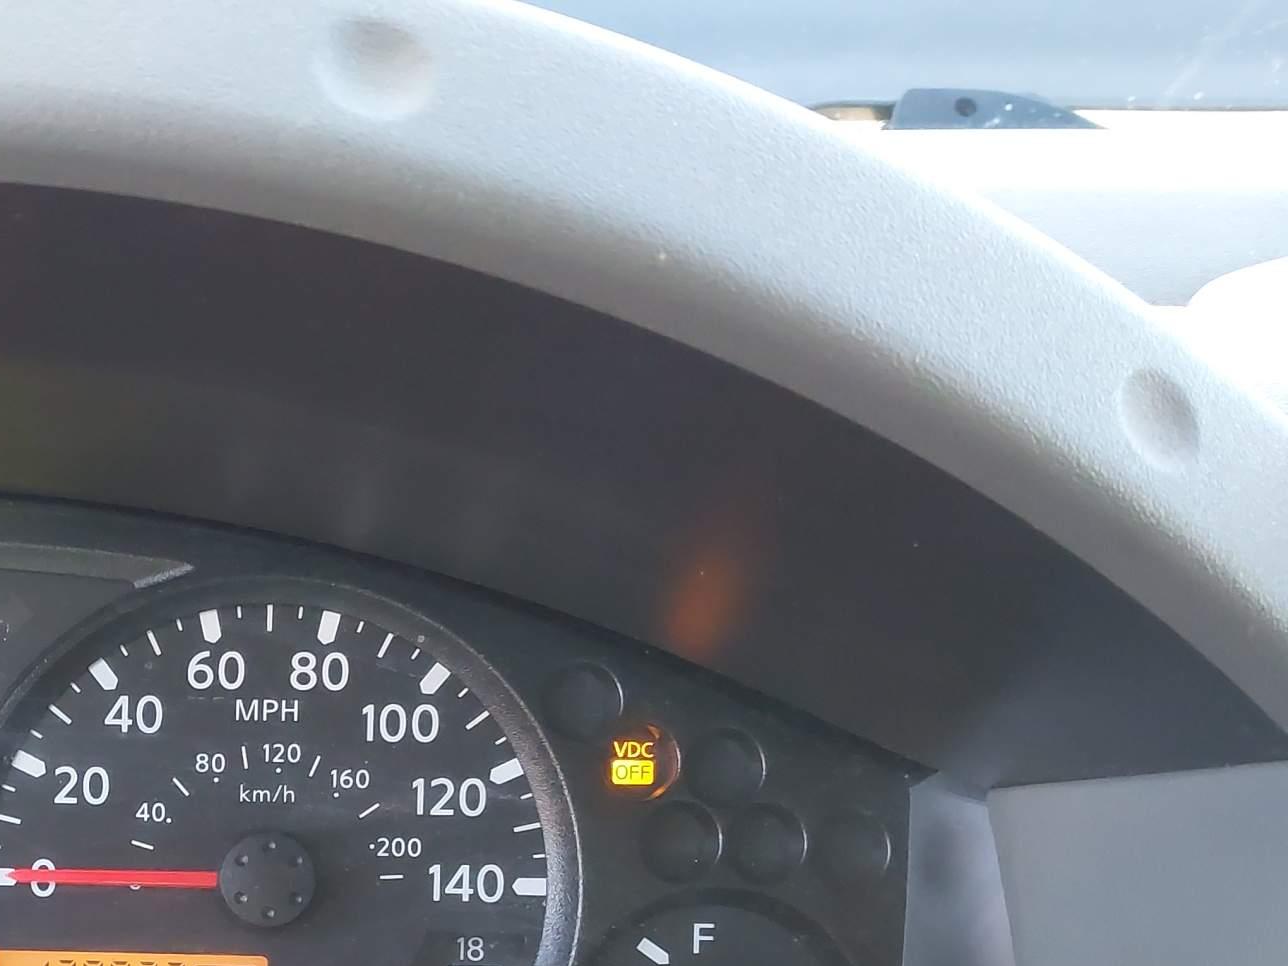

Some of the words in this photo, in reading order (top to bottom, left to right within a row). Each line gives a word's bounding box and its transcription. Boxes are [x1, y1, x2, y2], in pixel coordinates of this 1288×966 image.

[187, 650, 245, 690] 60
[289, 651, 349, 692] 80
[104, 695, 163, 734] 40
[235, 699, 299, 722] MPH
[362, 703, 439, 743] 100
[262, 743, 302, 763] 120
[614, 742, 654, 758] VDC
[195, 753, 226, 773] 80
[616, 765, 650, 780] OFF
[53, 765, 110, 805] 20
[330, 769, 370, 789] 160
[239, 783, 295, 803] km/h
[412, 777, 487, 817] 120
[376, 837, 422, 858] 200
[428, 864, 505, 903] 140
[457, 937, 484, 962] 18
[693, 923, 715, 954] F
